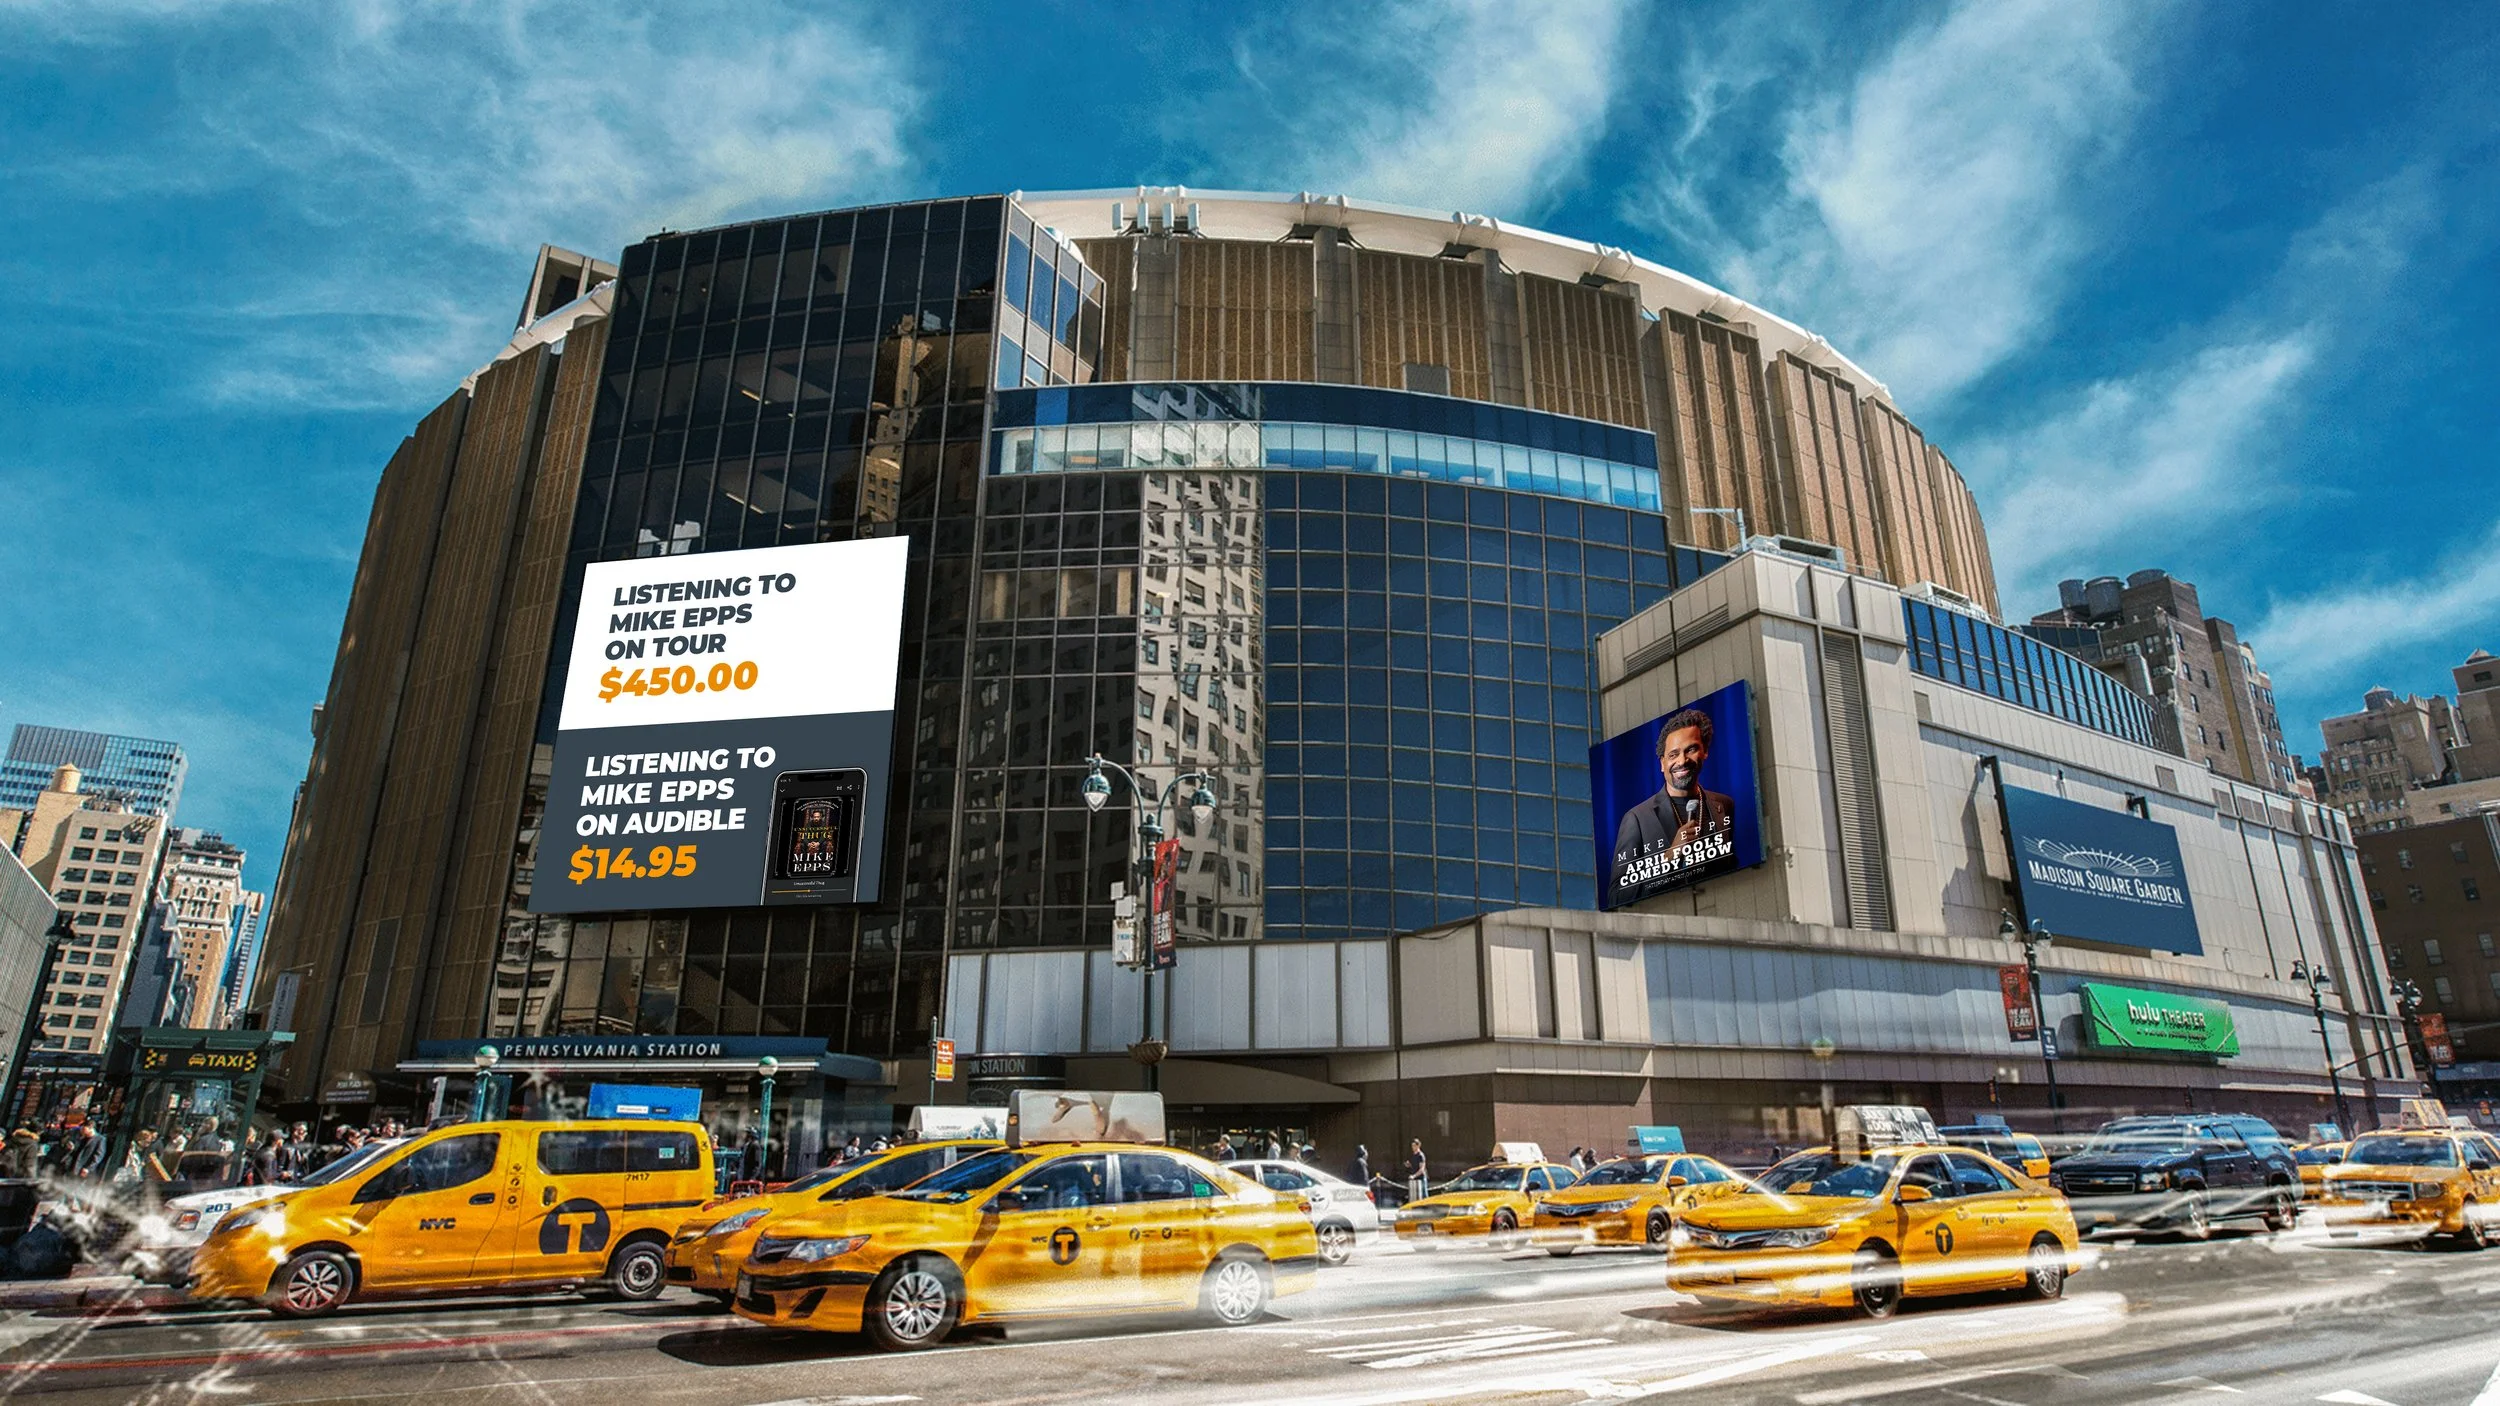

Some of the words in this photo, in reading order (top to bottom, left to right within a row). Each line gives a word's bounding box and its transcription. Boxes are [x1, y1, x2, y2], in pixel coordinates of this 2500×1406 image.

[614, 577, 752, 607] LISTENING
[759, 573, 797, 594] TO
[609, 610, 676, 633] MIKE
[683, 604, 753, 628] EPPS
[605, 639, 645, 661] ON
[653, 634, 727, 657] TOUR
[598, 661, 759, 703] $450.00
[586, 748, 730, 778] LISTENING
[737, 746, 776, 769] TO
[581, 783, 653, 807] MIKE
[660, 778, 735, 802] EPPS
[576, 813, 619, 837] ON
[621, 808, 747, 835] AUDIBLE
[799, 831, 834, 840] THUG
[1618, 839, 1665, 862] MIKE
[1680, 816, 1731, 841] EPPS
[569, 845, 697, 884] $14.95
[793, 852, 834, 862] MIKE
[794, 862, 831, 872] EPPS
[1620, 858, 1681, 887] COMEDY
[1685, 841, 1733, 867] SHOW
[1626, 852, 1669, 875] APRIL
[1672, 833, 1724, 860] FOOLS
[2028, 860, 2085, 888] MADISON
[2086, 870, 2133, 896] SQUARE
[2135, 878, 2184, 905] GARDEN
[2128, 999, 2160, 1021] hulu
[2162, 1008, 2206, 1028] THEATER
[207, 1054, 244, 1067] TAXI
[504, 1044, 638, 1057] PENNSYLVANIA
[647, 1043, 721, 1056] STATION
[981, 1058, 1026, 1073] STATION
[626, 1173, 650, 1182] 7H17
[205, 1203, 232, 1214] 203
[419, 1217, 456, 1230] NYC
[558, 1211, 596, 1254] T
[1055, 1234, 1075, 1261] T
[1938, 1229, 1949, 1252] T
